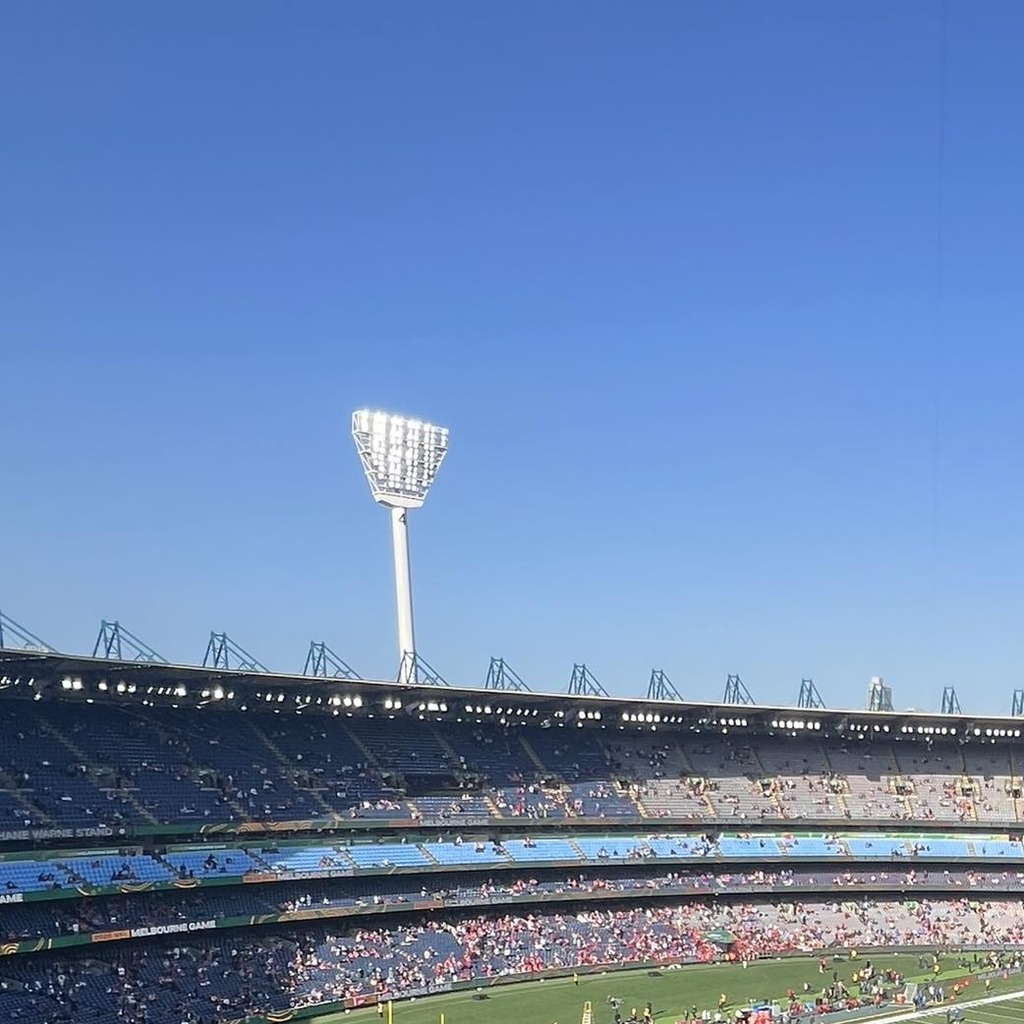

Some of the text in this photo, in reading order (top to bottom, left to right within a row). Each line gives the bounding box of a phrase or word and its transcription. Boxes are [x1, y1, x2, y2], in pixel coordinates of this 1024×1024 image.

[32, 829, 73, 840] WARNE
[76, 828, 113, 838] STAND
[131, 923, 188, 937] MELBOURNE
[189, 920, 216, 931] GAME
